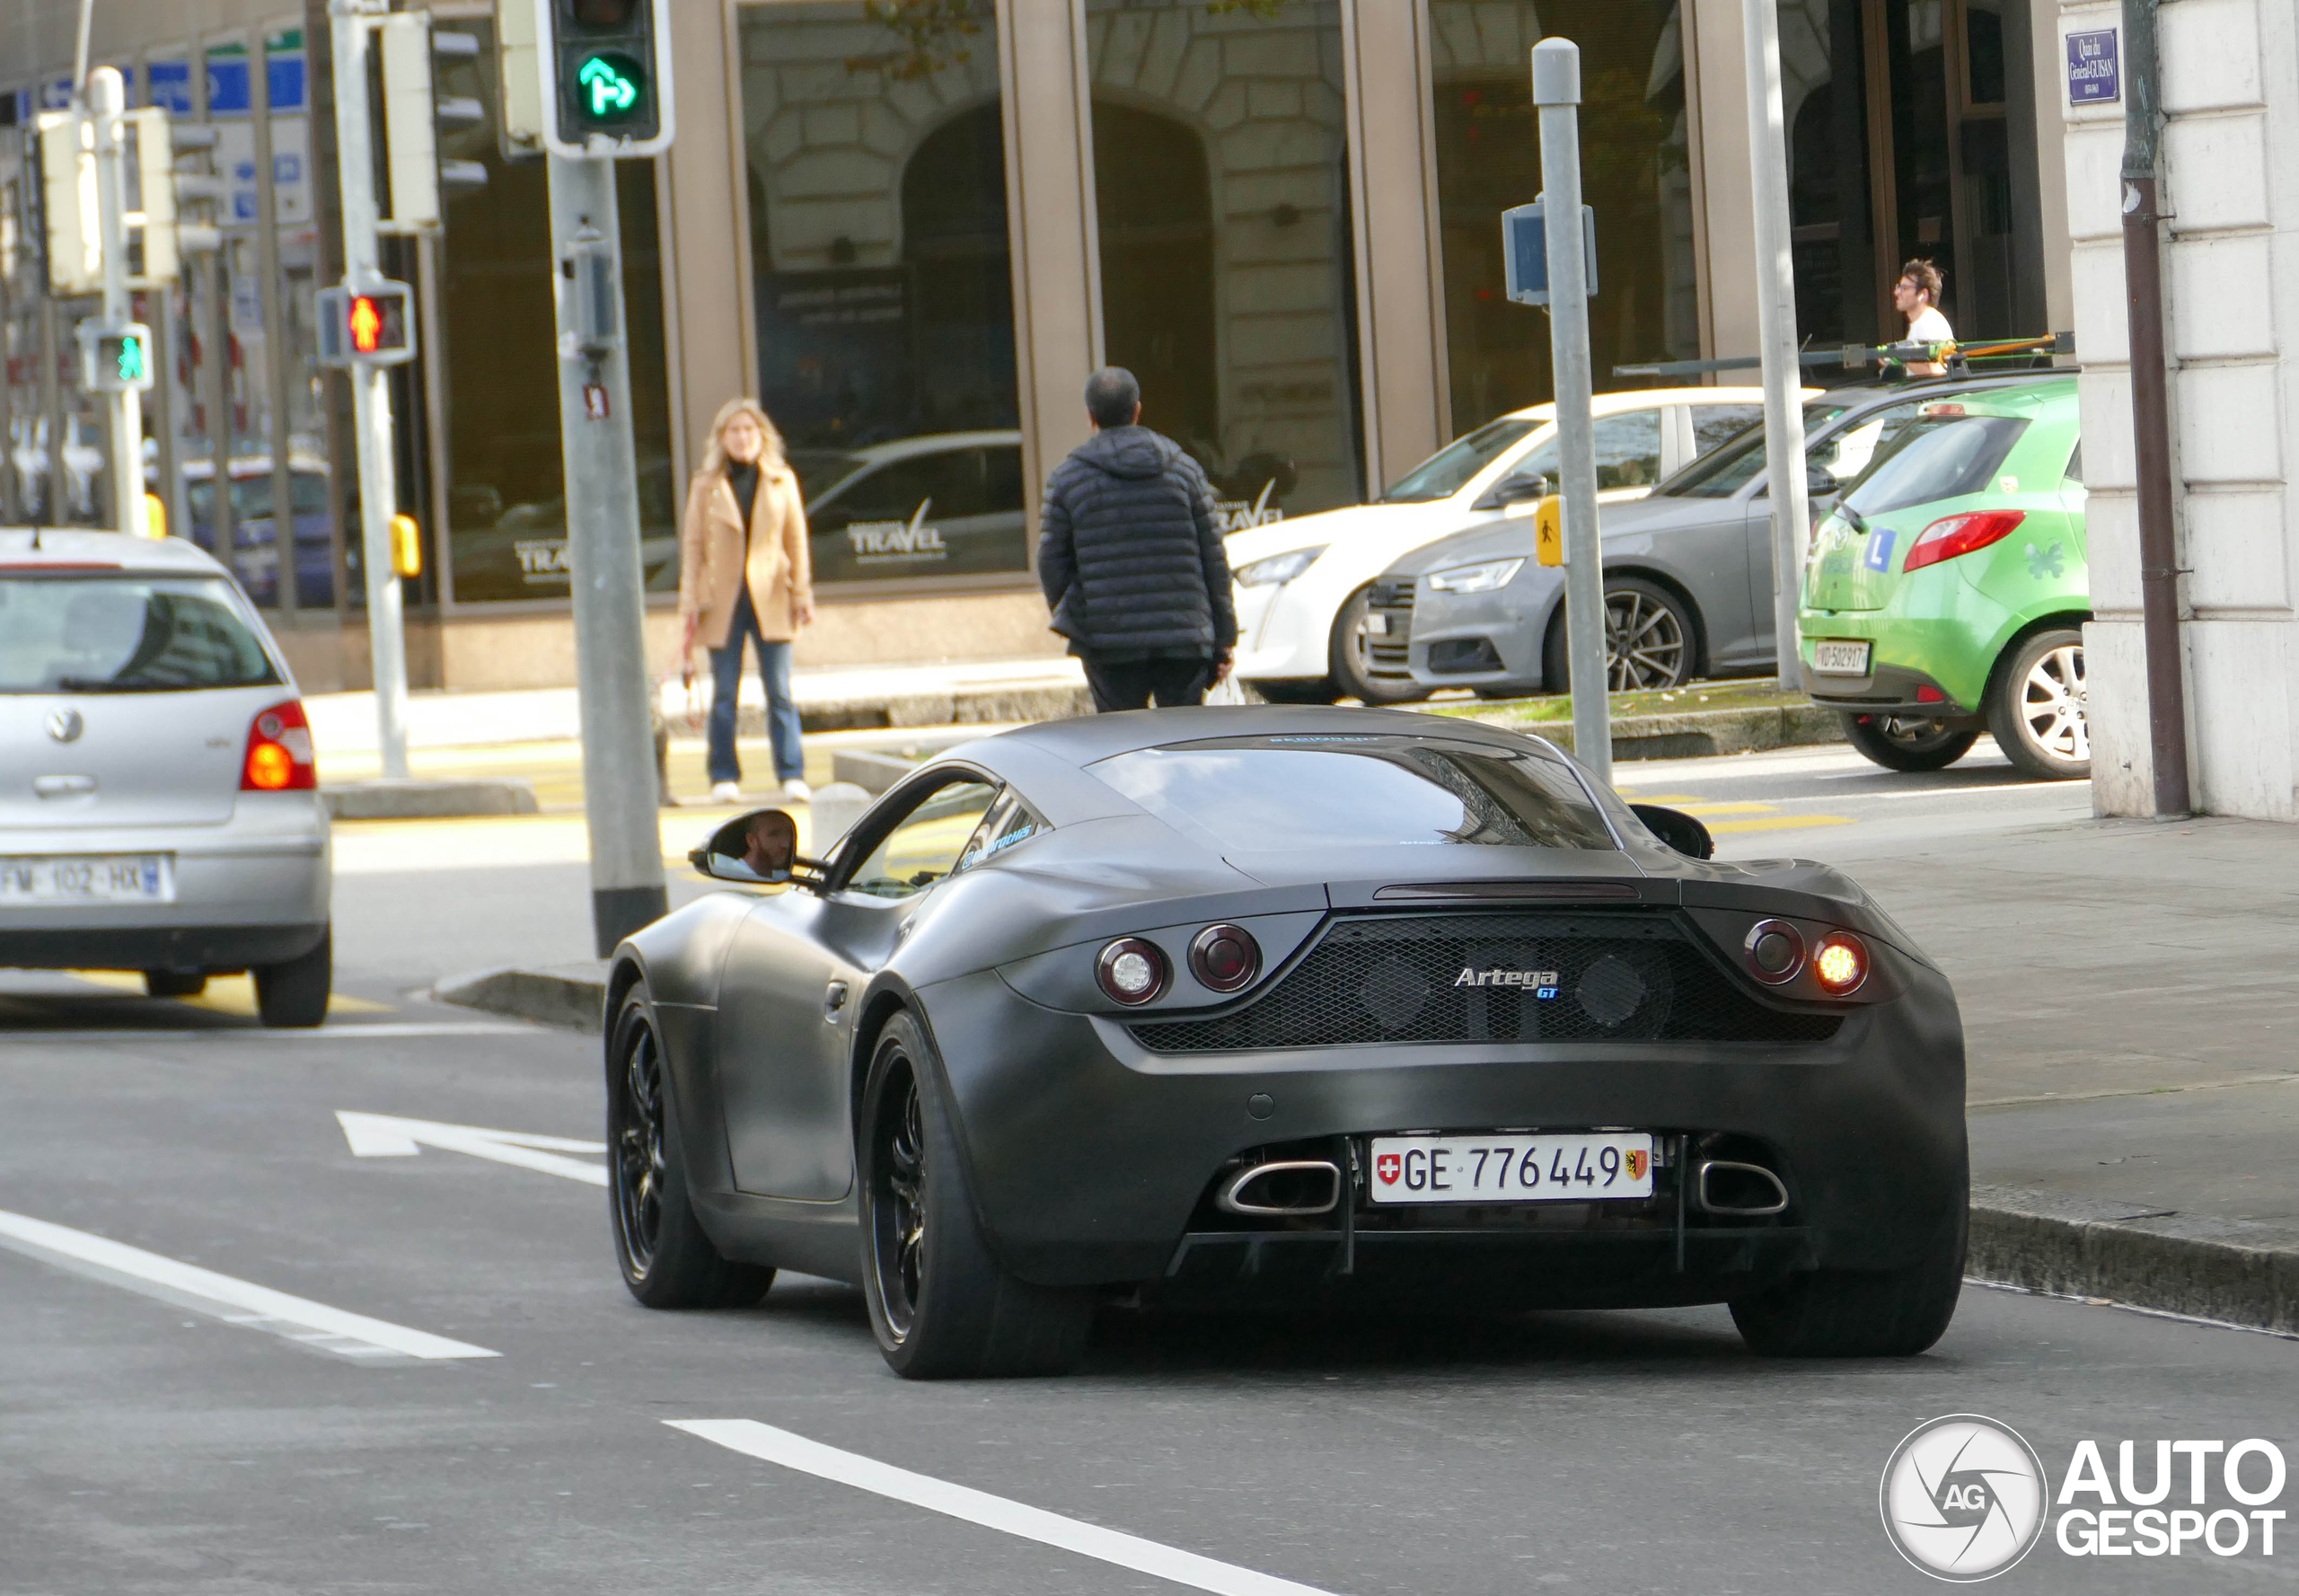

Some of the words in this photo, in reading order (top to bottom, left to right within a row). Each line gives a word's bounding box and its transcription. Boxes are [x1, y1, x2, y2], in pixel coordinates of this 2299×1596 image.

[2079, 39, 2092, 60] Quai
[2093, 37, 2101, 55] du
[2069, 58, 2113, 80] Général-GUISAN
[848, 498, 947, 553] TRAVEL
[1871, 533, 1883, 565] L
[1455, 968, 1558, 991] Artega
[1537, 988, 1558, 999] GT
[1405, 1148, 1452, 1191] GE
[1469, 1146, 1620, 1190] 776449
